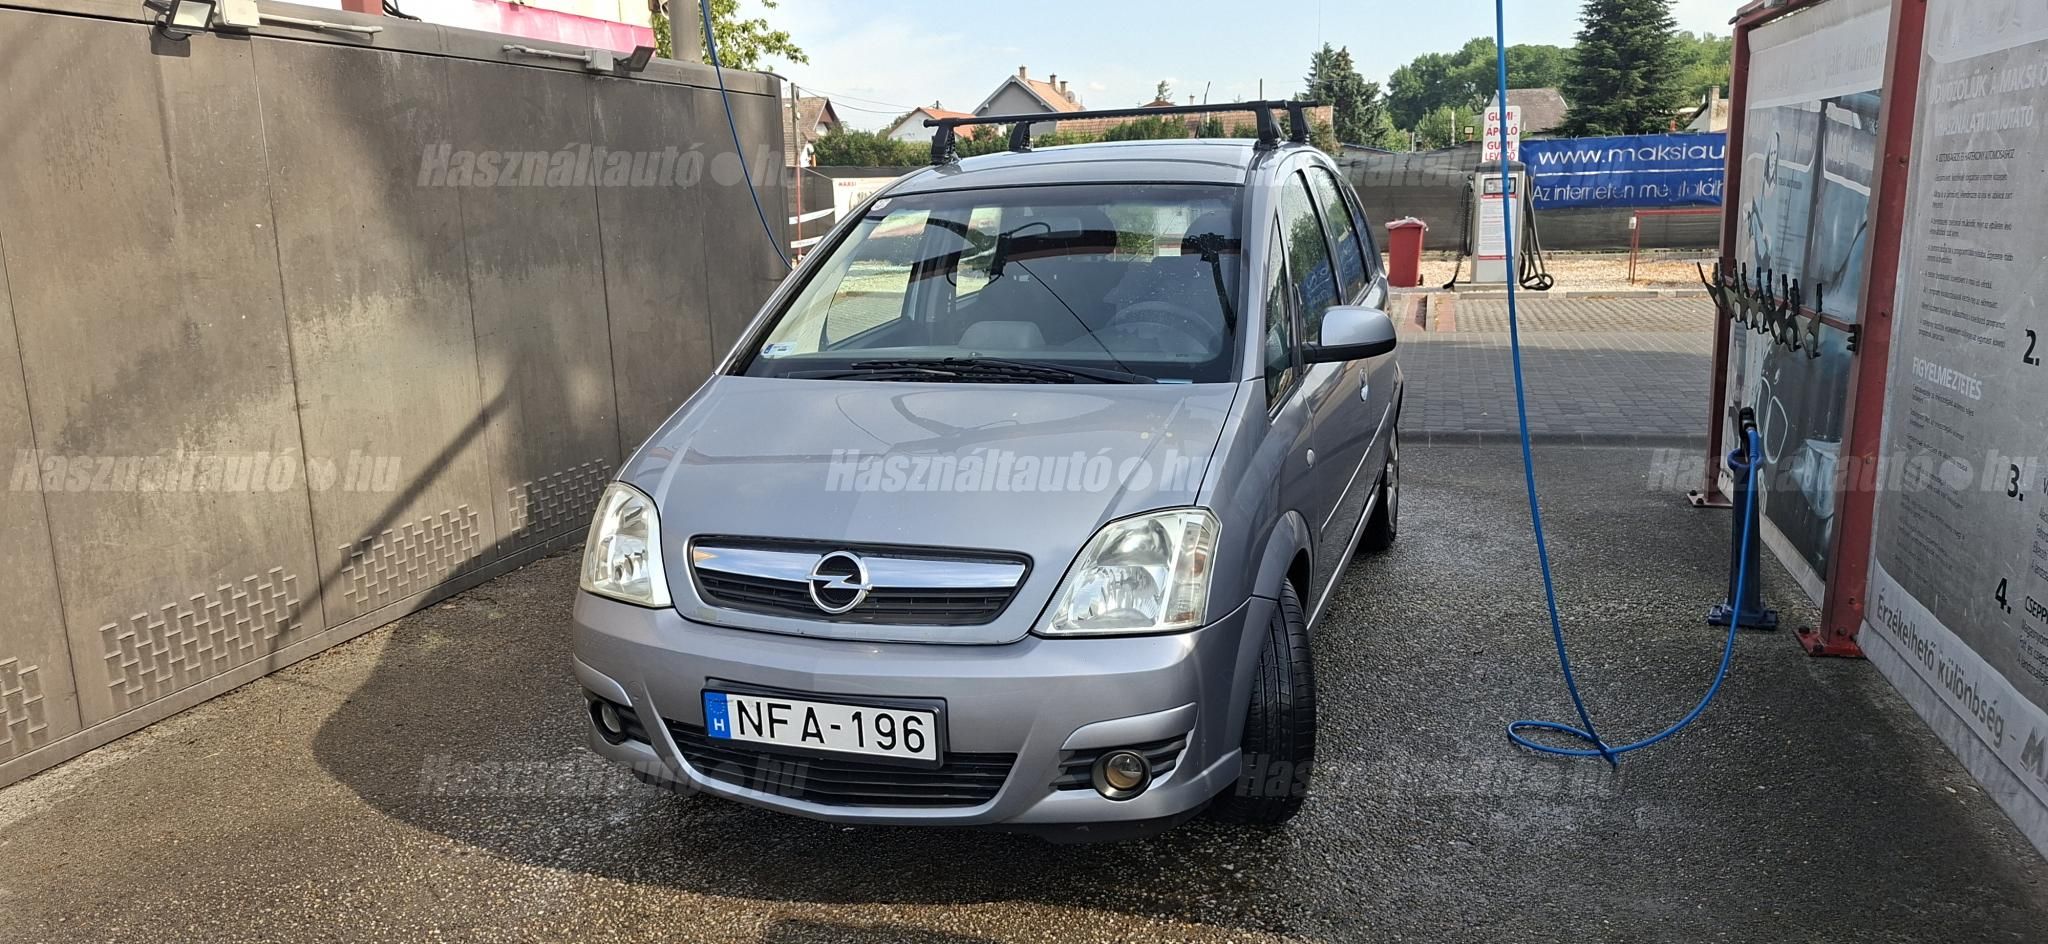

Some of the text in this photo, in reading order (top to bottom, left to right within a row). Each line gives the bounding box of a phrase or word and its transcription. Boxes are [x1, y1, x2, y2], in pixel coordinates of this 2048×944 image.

[2000, 64, 2036, 93] MAKSI
[1486, 123, 1518, 136] ÁPLÓ
[1538, 142, 1725, 165] www.maksiau
[1532, 185, 1550, 201] Az
[2023, 328, 2040, 366] 2.
[1912, 356, 1982, 400] FIGYELMEZTETÉS
[2007, 463, 2024, 501] 3.
[1994, 577, 2011, 614] 4.
[2025, 595, 2048, 624] CSEPP
[1876, 588, 1936, 671] Érzékelhető
[1937, 655, 2005, 748] különbség
[2020, 727, 2048, 784] M
[713, 717, 725, 732] H
[737, 700, 925, 753] NFA-196
